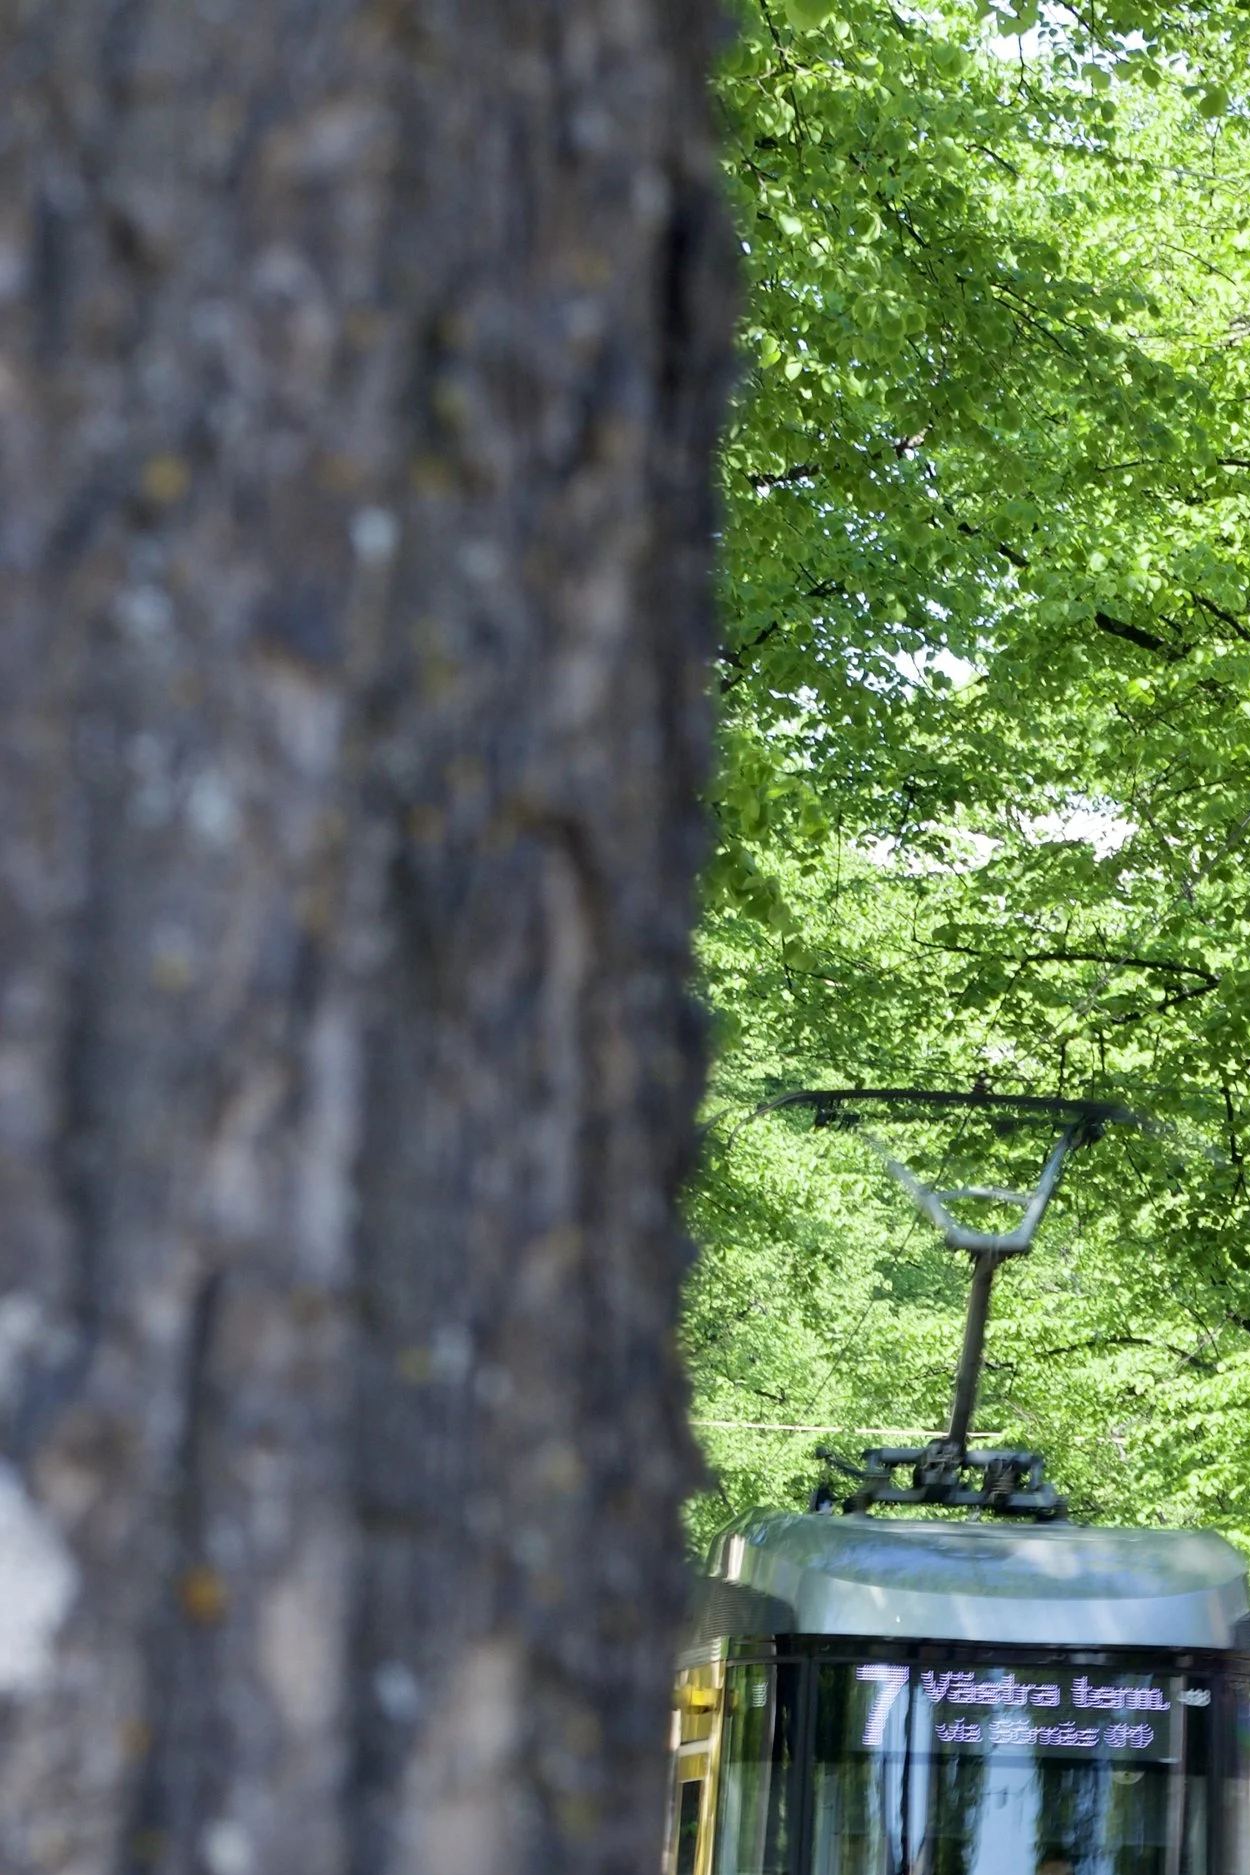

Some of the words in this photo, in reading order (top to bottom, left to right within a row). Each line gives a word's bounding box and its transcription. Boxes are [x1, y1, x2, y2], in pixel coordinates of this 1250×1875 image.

[856, 1664, 909, 1746] 7
[920, 1670, 1061, 1706] Västra
[935, 1717, 983, 1742] via
